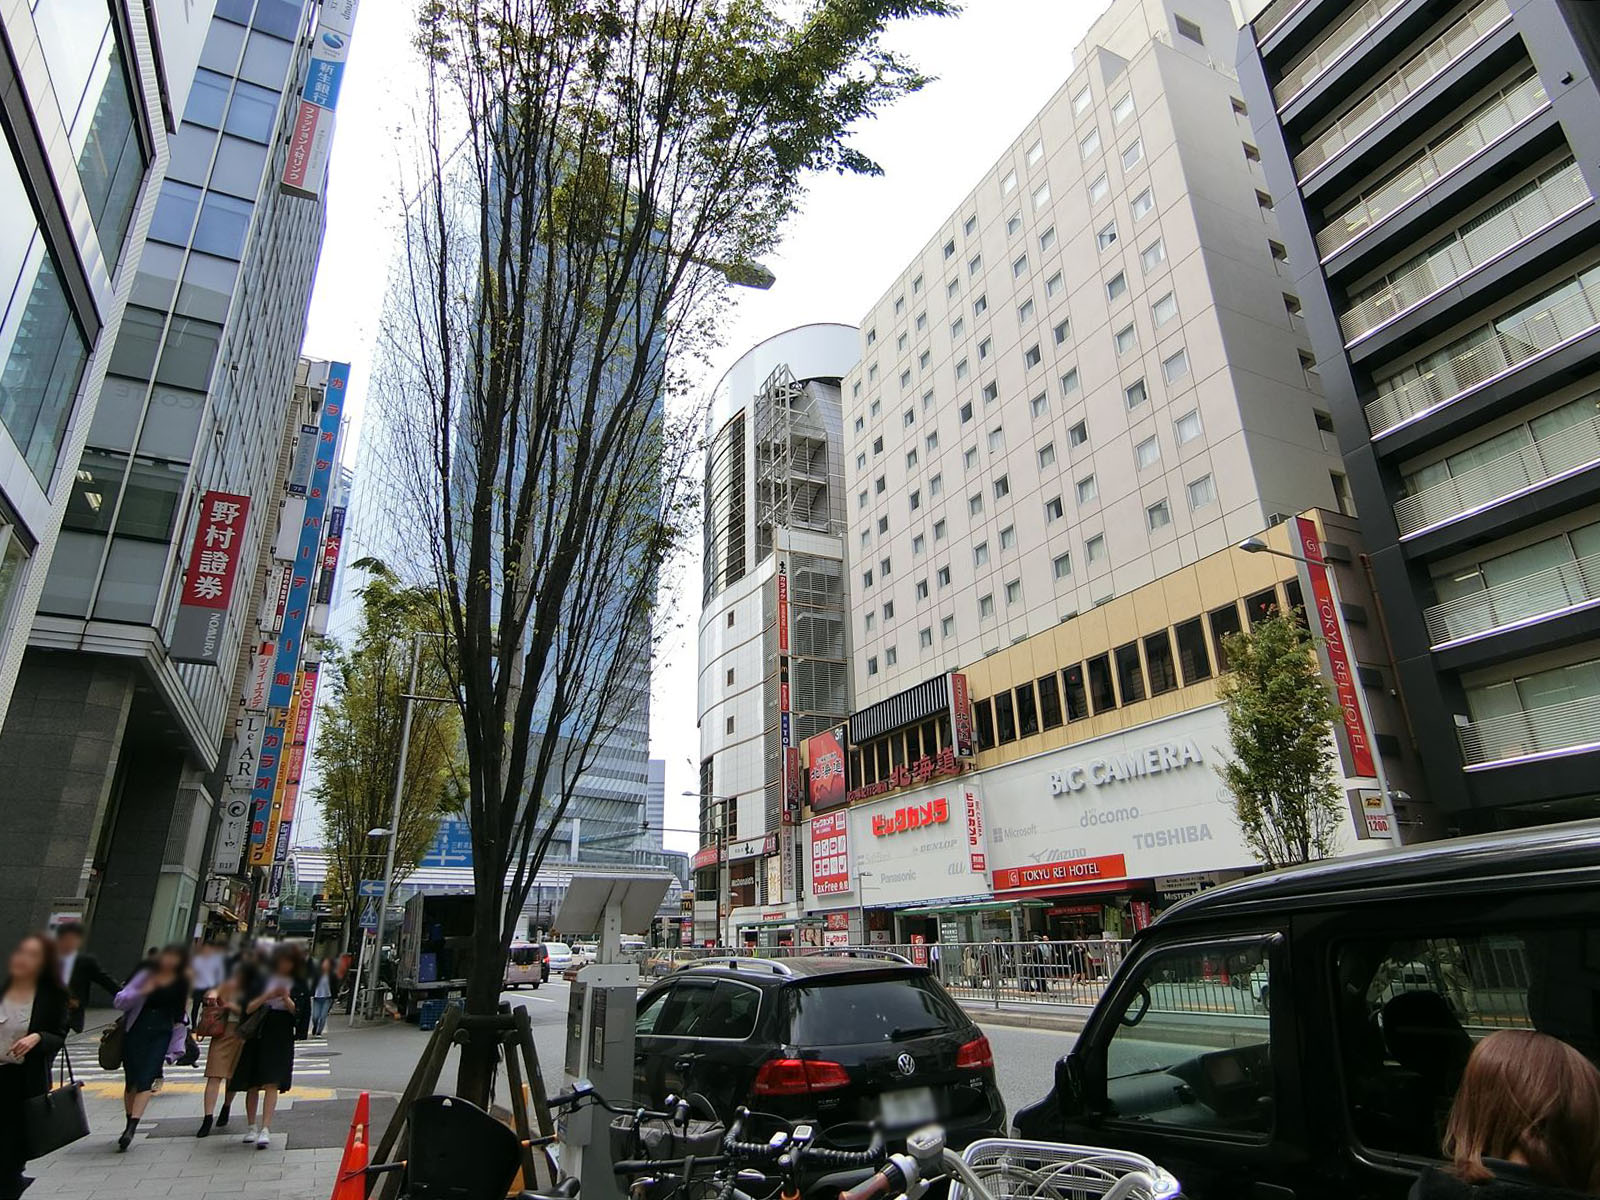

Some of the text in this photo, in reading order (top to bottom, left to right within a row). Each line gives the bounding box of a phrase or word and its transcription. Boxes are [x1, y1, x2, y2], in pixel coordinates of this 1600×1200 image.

[314, 62, 335, 104] 新生銀行
[193, 500, 240, 600] 野村證券
[202, 612, 221, 657] NOMURA
[1319, 597, 1366, 753] TOKYU REI HOTEL
[810, 759, 844, 781] 北海道
[888, 745, 962, 787] 北海道
[1048, 738, 1204, 796] BIC CAMERA
[872, 797, 949, 838] ビックカメラ
[966, 792, 978, 846] ビックカメラ
[1004, 824, 1038, 838] Microsoft
[1132, 824, 1212, 850] TOSHIBA
[880, 869, 917, 884] Panasonic
[948, 862, 966, 876] au
[1022, 861, 1100, 883] TOKYU REI HOTEL
